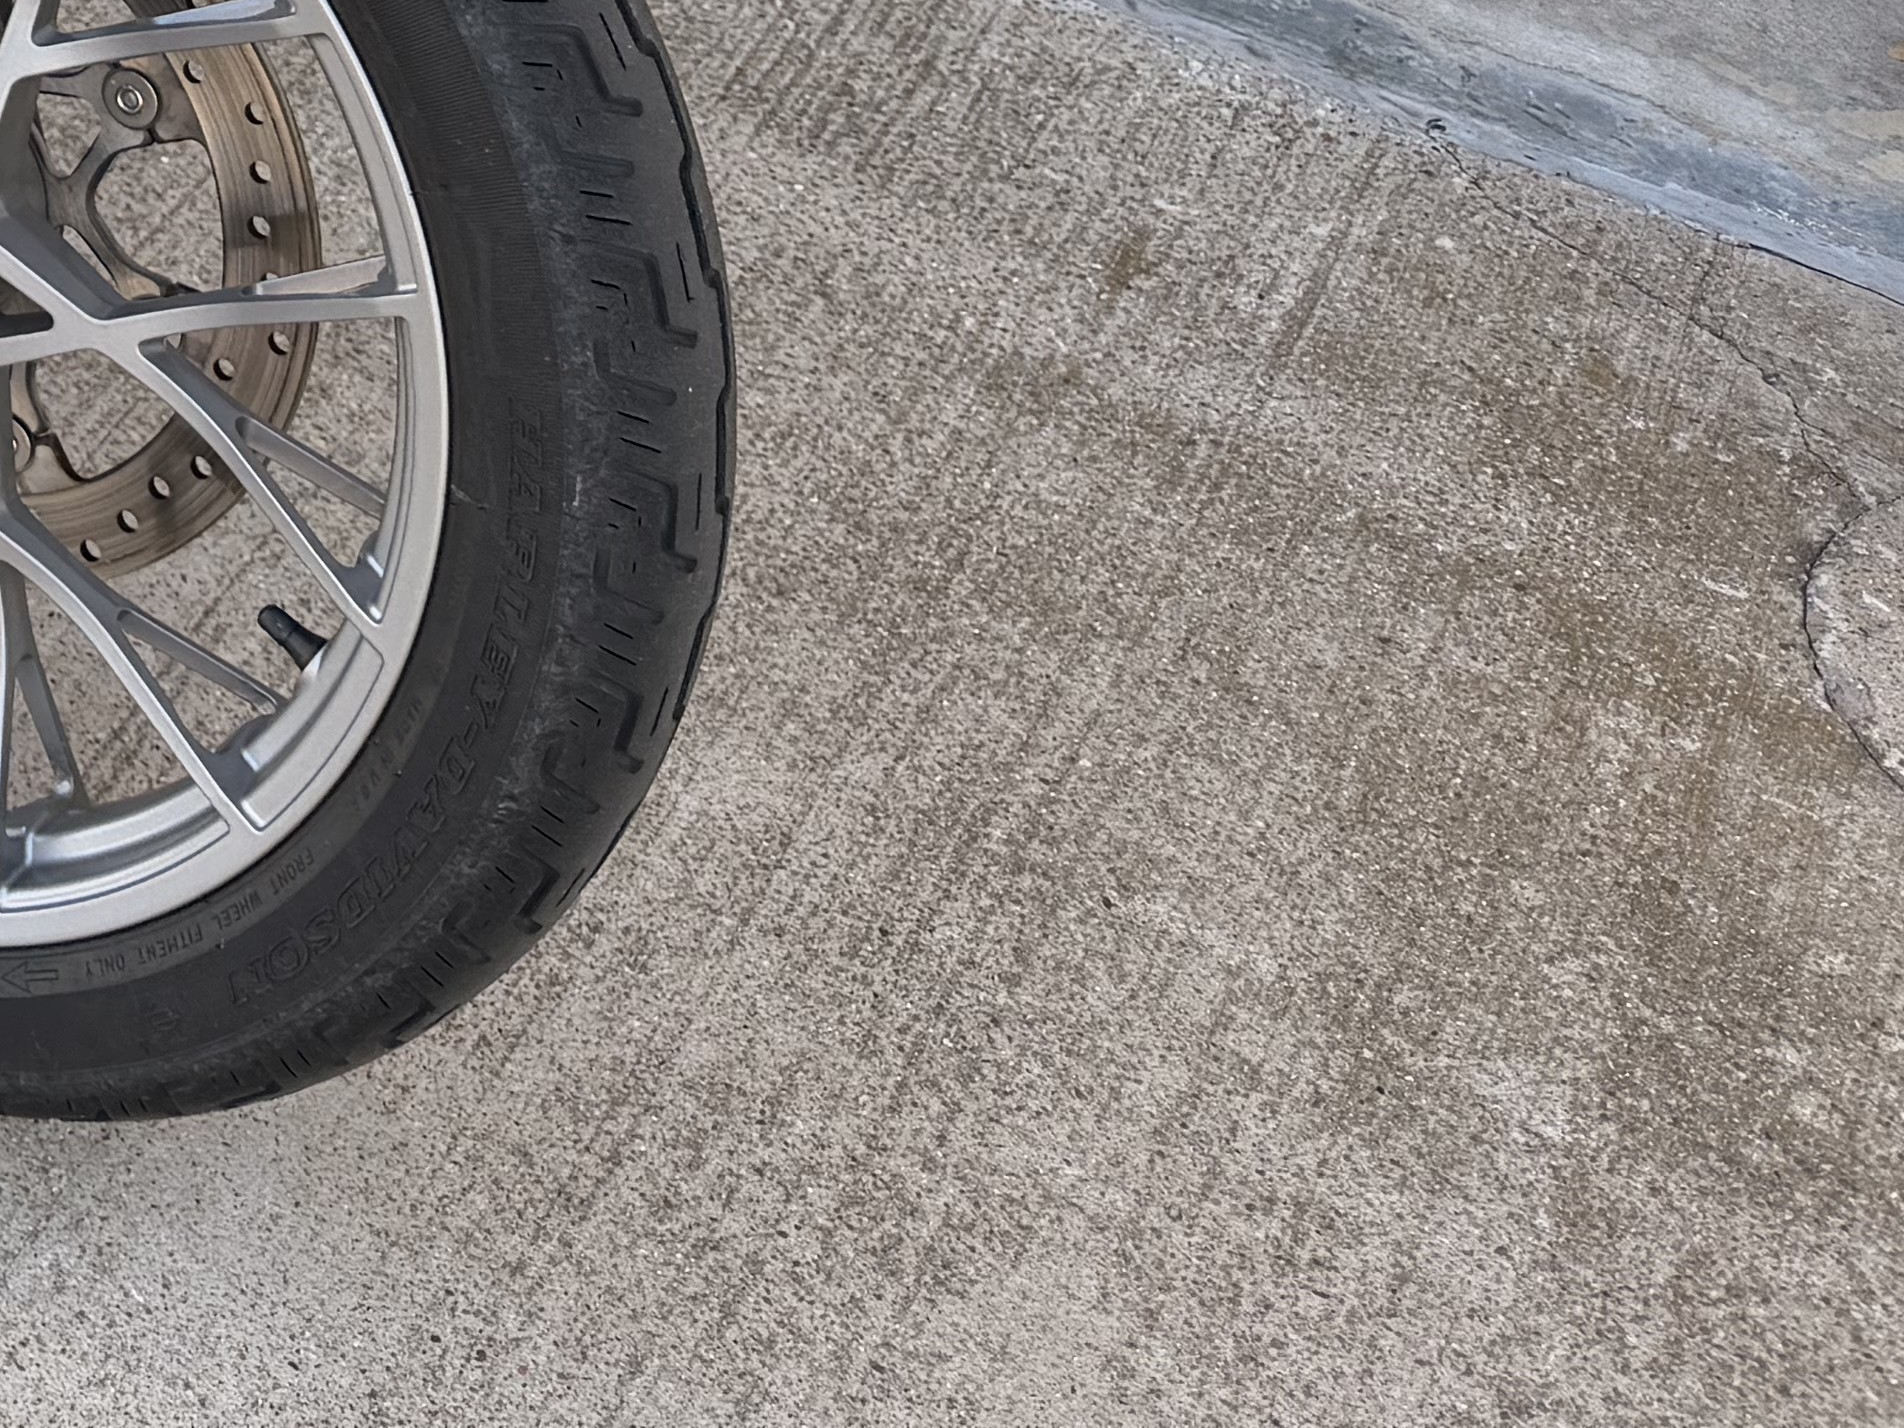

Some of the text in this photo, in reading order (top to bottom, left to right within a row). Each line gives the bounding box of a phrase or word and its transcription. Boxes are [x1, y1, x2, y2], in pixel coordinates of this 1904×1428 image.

[84, 849, 315, 979] FRONT WHEEL FITMENT ONLY
